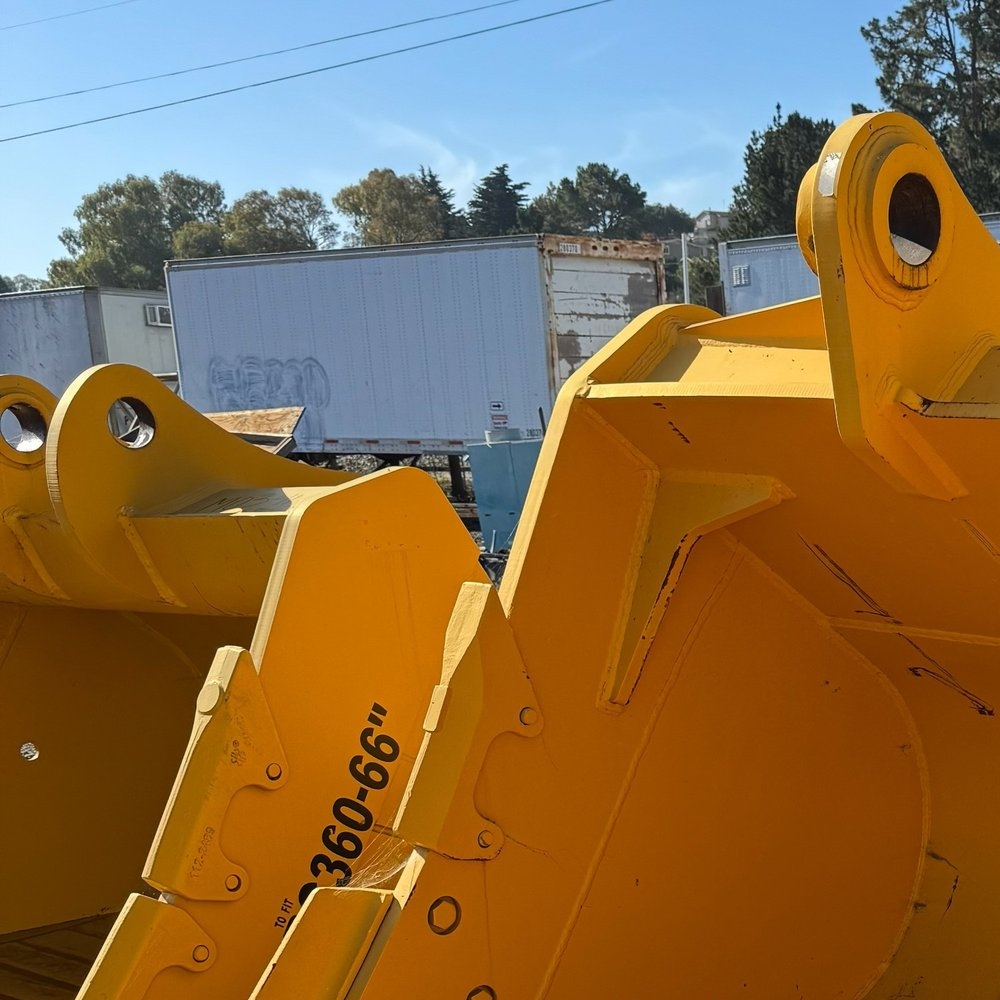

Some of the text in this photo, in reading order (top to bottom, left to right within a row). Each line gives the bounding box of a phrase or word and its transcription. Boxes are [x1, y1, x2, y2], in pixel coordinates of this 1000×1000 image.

[283, 702, 400, 937] 360-66"
[274, 898, 294, 928] TO FIT
